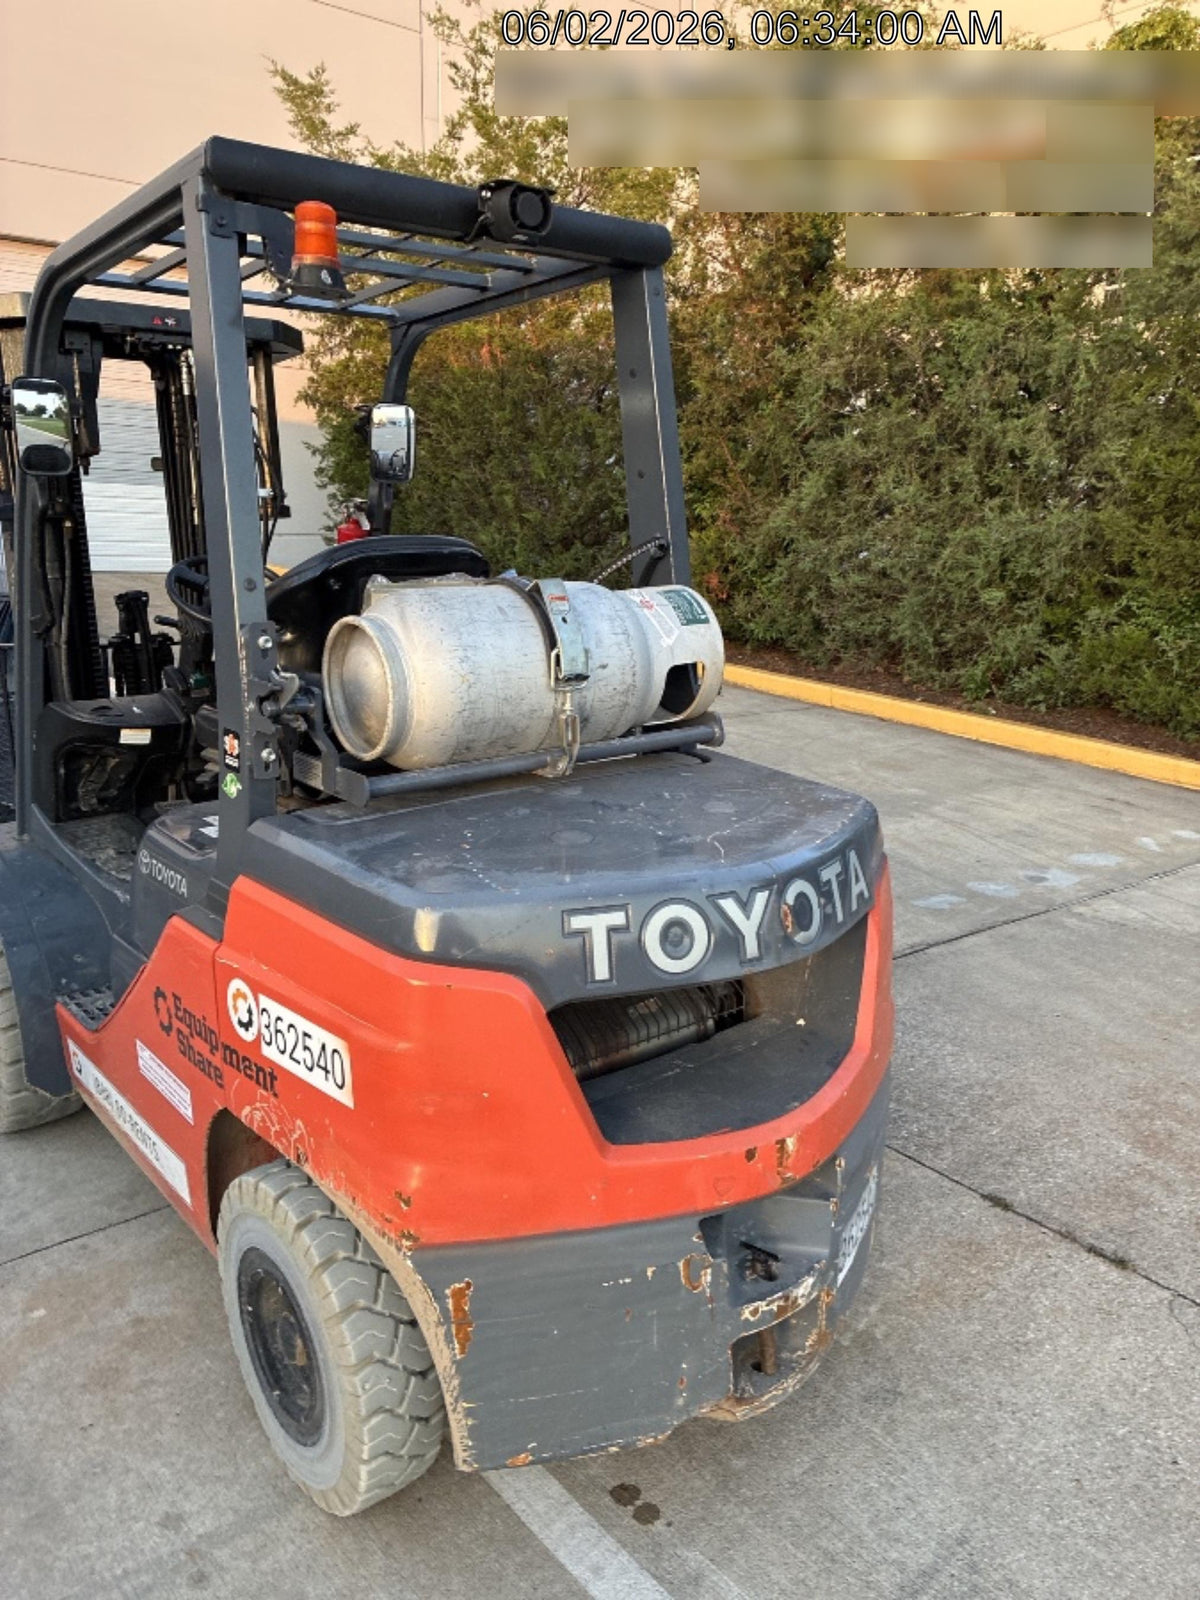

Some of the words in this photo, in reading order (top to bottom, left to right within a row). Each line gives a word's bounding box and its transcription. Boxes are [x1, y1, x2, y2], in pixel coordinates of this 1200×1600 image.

[152, 859, 187, 898] TOYOTA
[564, 850, 870, 985] TOYOTA
[176, 1027, 224, 1089] Share
[260, 1007, 346, 1090] 362540
